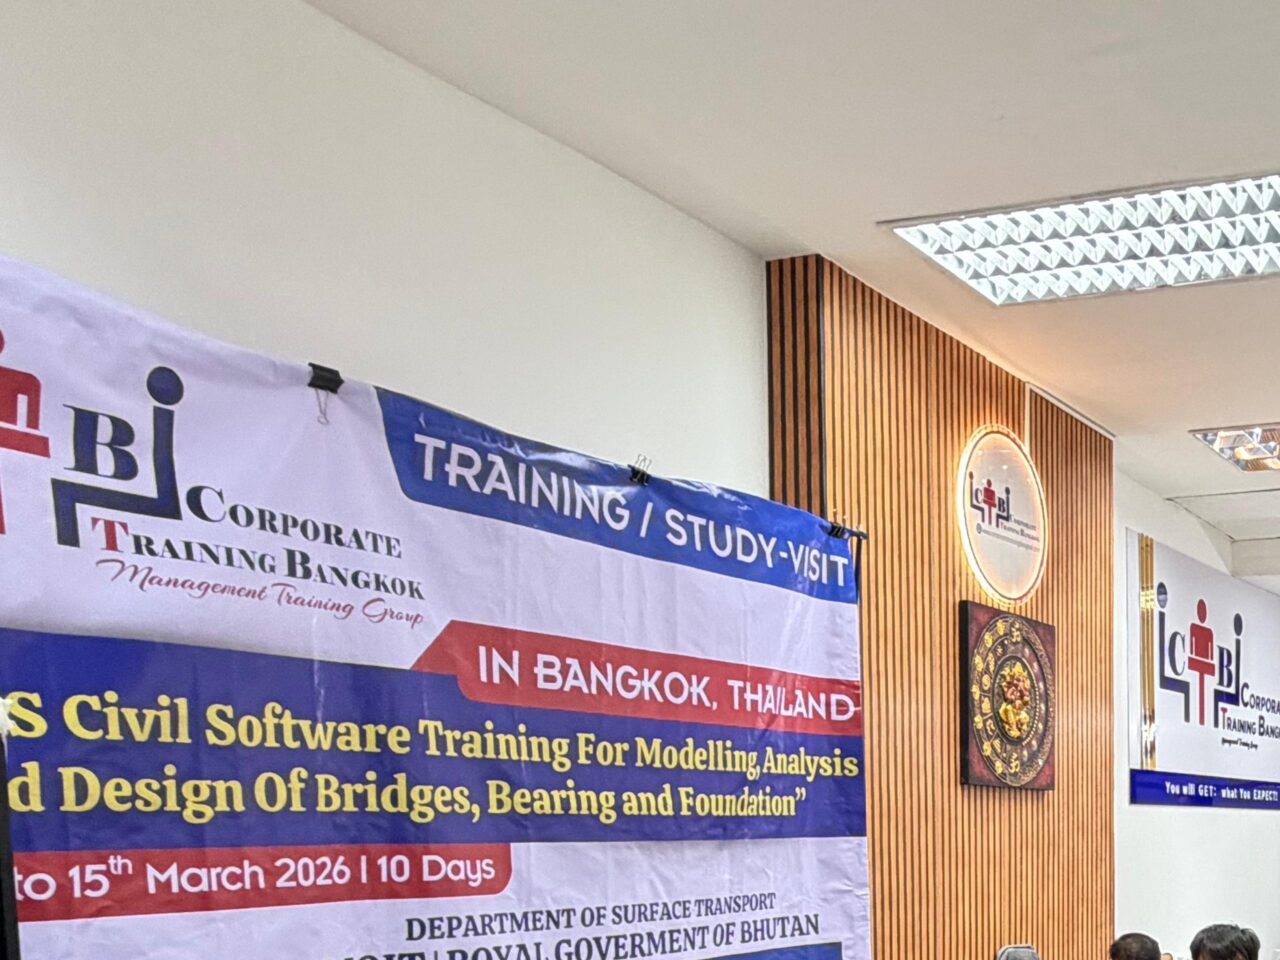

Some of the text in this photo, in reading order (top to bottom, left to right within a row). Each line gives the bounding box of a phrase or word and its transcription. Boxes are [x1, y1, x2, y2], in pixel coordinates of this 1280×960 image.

[63, 403, 138, 481] B
[186, 486, 402, 559] CORPORATE
[414, 433, 628, 530] TRAINING
[666, 509, 849, 586] STUDY-VISIT
[91, 517, 425, 600] TRAINING BANGKOK
[96, 559, 424, 629] Management Training Group
[478, 646, 855, 722] IN BANGKOK, THAILAND
[63, 691, 192, 744] Civil
[205, 701, 411, 755] Software
[419, 718, 572, 772] Training
[577, 732, 630, 767] For
[635, 735, 762, 780] Modelling,
[762, 745, 859, 781] Analysis
[1220, 707, 1257, 735] TRAINING
[57, 763, 246, 824] Design
[254, 766, 309, 812] Of
[315, 771, 480, 824] Bridges,
[487, 778, 617, 824] Bearing
[622, 783, 674, 816] and
[1165, 781, 1180, 794] You
[1182, 782, 1195, 796] will
[1198, 784, 1217, 797] GET:
[1221, 786, 1238, 799] what
[1239, 788, 1251, 799] You
[13, 866, 57, 901] to
[146, 858, 265, 894] March
[275, 855, 351, 888] 2026
[377, 854, 410, 883] 10
[423, 854, 496, 886] Days
[405, 892, 776, 941] DEPARTMENT OF SURFACE TRANSPORT
[713, 922, 736, 947] OF
[740, 913, 820, 944] BHUTAN
